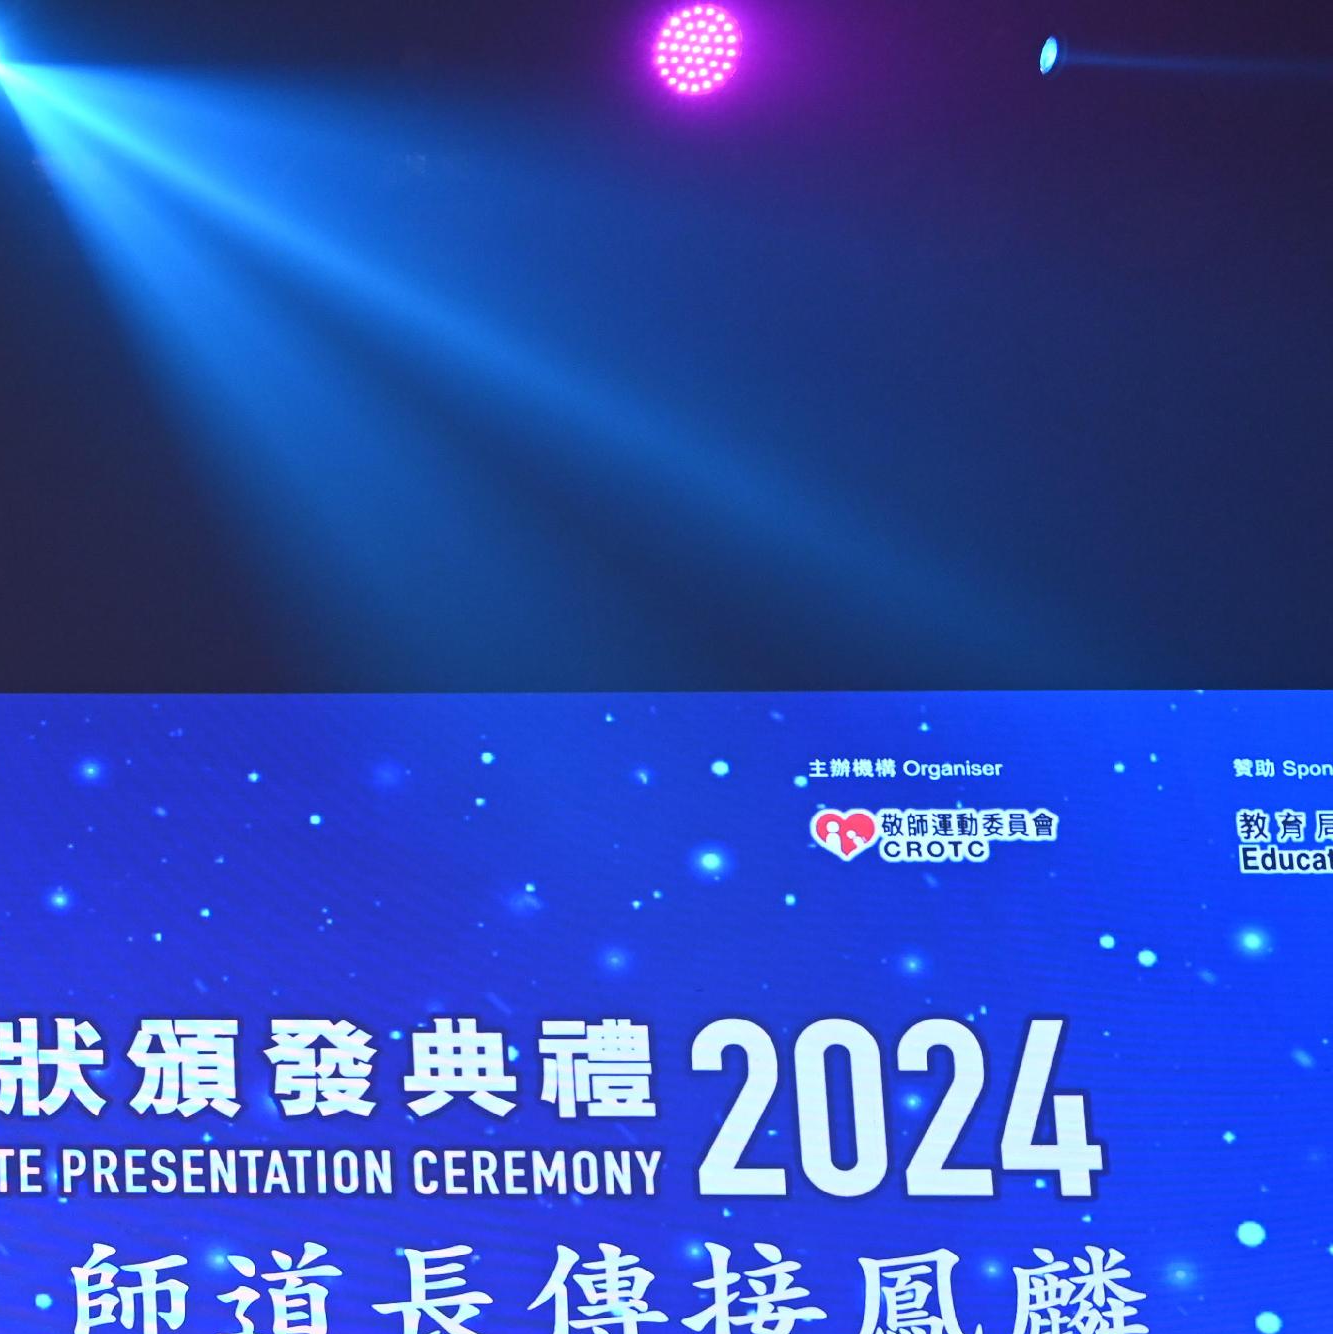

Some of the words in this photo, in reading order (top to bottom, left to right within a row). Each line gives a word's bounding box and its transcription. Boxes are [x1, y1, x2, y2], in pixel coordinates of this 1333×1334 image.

[808, 758, 897, 778] 主辦機構
[903, 760, 1003, 780] Organiser
[881, 812, 1054, 837] 敬師運動委員會
[884, 840, 985, 858] CROTC
[691, 1018, 1104, 1198] 2024
[63, 1148, 395, 1196] PRESENTATION
[412, 1149, 662, 1197] CEREMONY
